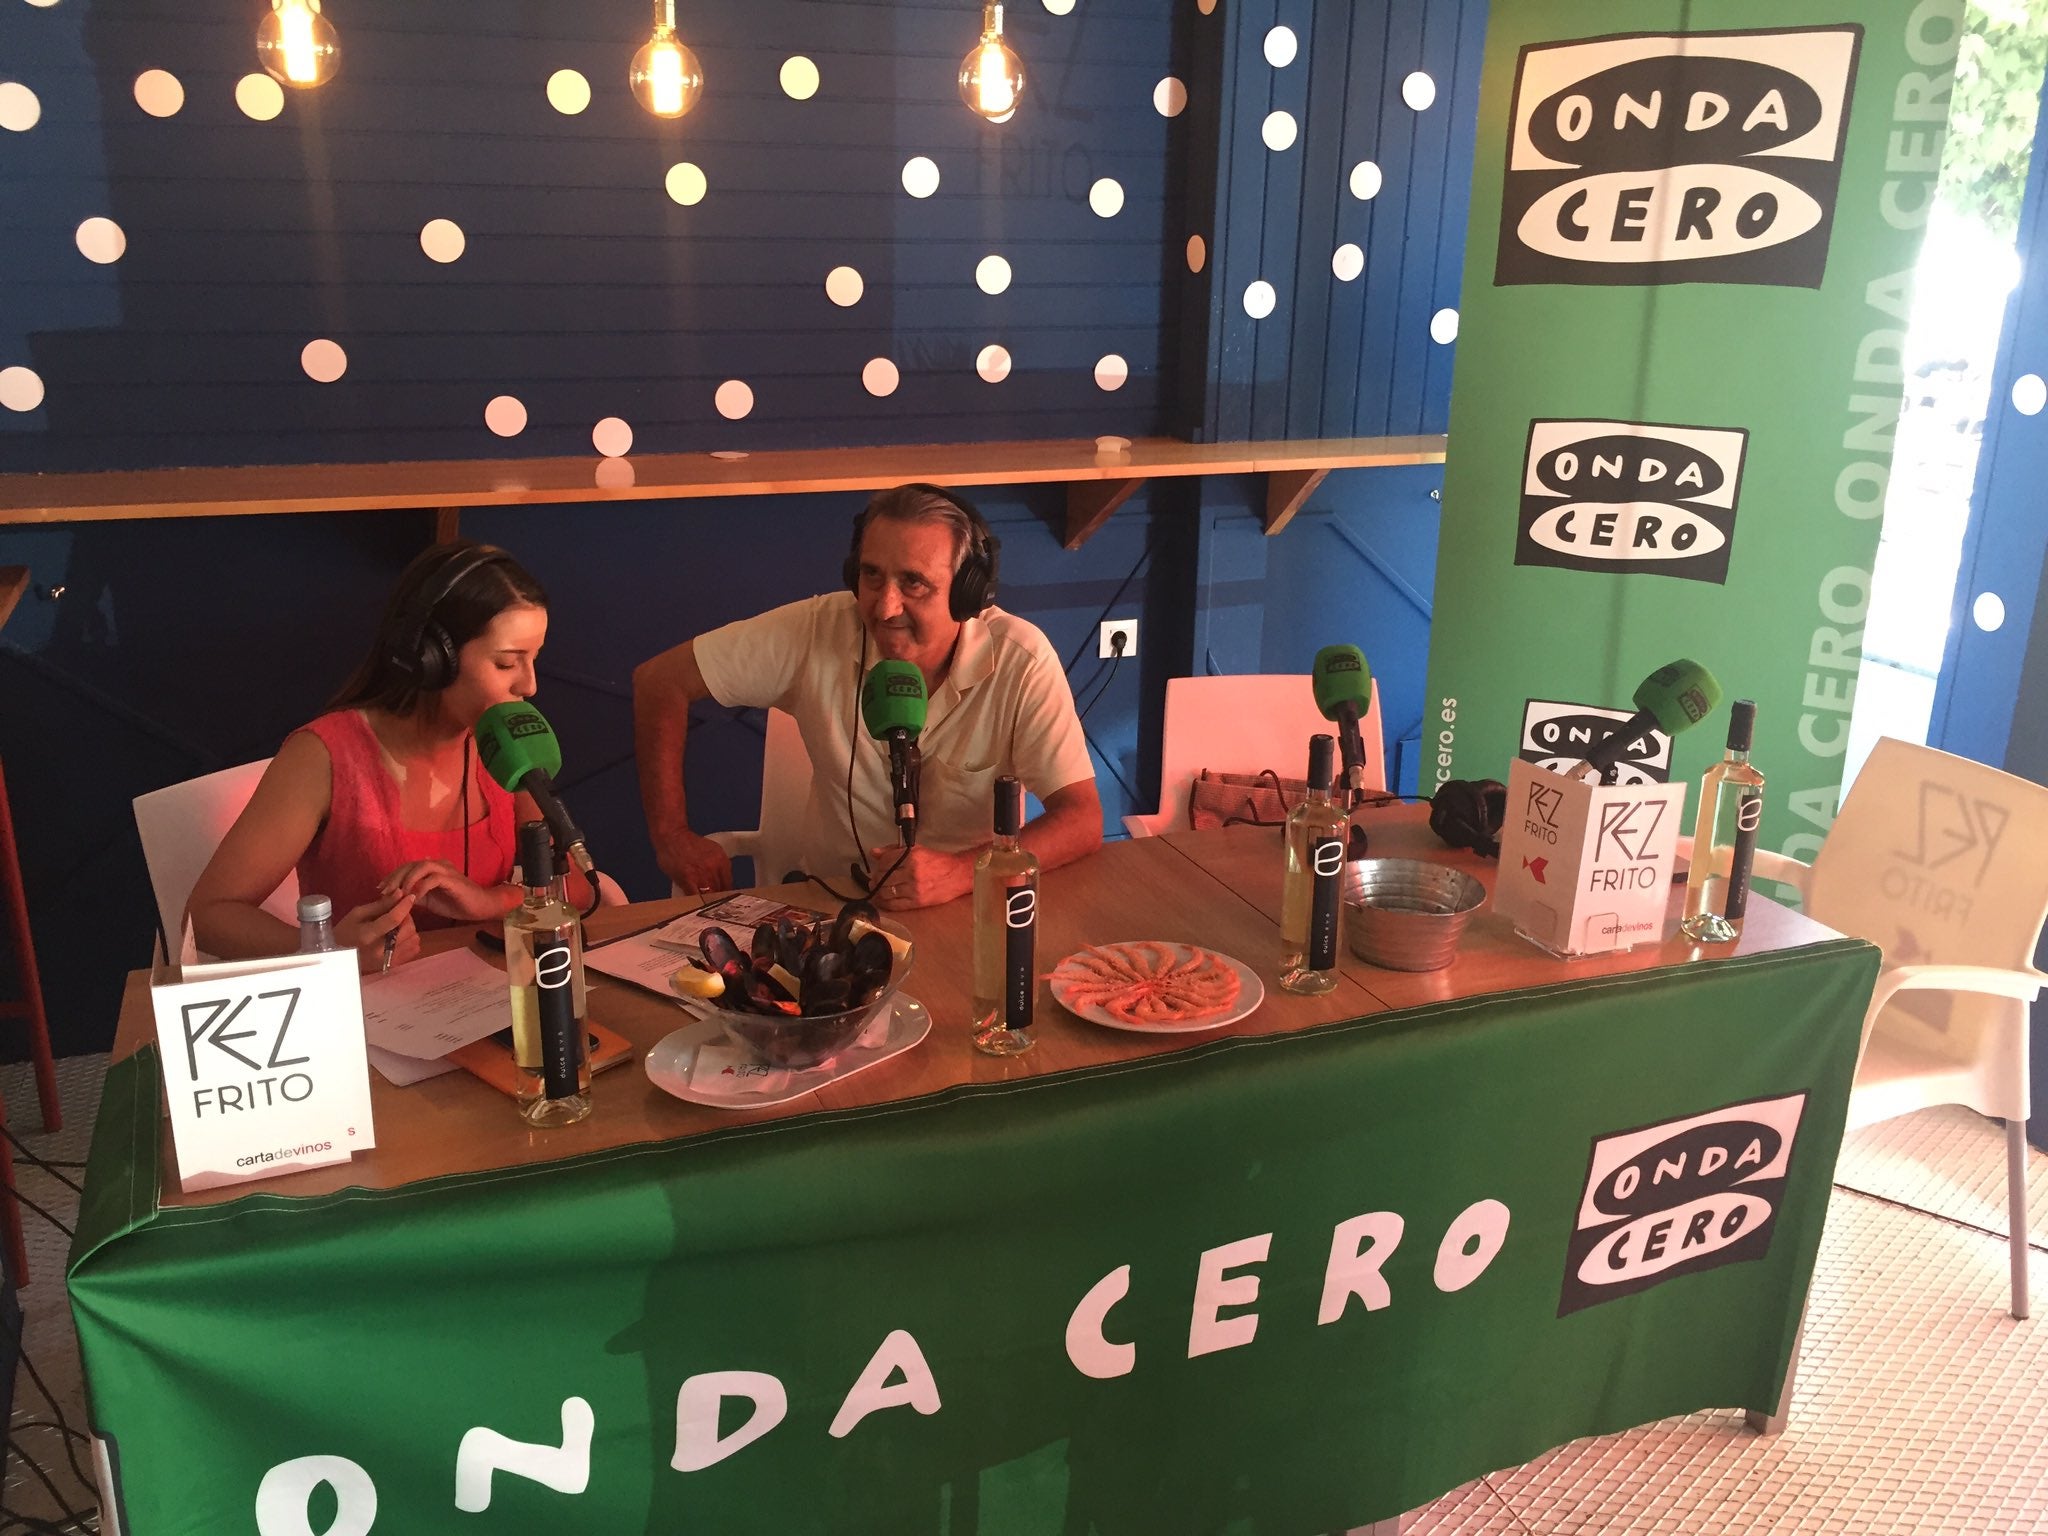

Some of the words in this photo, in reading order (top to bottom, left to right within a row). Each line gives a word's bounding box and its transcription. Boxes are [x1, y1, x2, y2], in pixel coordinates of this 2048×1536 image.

[1555, 89, 1790, 142] ONDA
[1879, 0, 1965, 231] CERO
[1555, 186, 1779, 242] CERO
[1834, 263, 1912, 521] ONDA
[1554, 451, 1705, 489] ONDA
[1555, 510, 1698, 551] CERO
[1797, 565, 1872, 758] CERO
[1435, 698, 1457, 793] cero.es
[1543, 722, 1648, 755] ONA
[1524, 820, 1558, 845] FRITO
[1526, 781, 1564, 829] PEZ
[1594, 800, 1668, 863] PEZ
[1590, 866, 1656, 892] FRITO
[180, 987, 310, 1081] PEZ
[193, 1072, 314, 1119] FRITO
[236, 1141, 332, 1167] cartadevinos
[1613, 1138, 1761, 1200] ONDA
[1607, 1204, 1748, 1270] CERO
[255, 1329, 942, 1536] ONDA
[1065, 1199, 1511, 1378] CERO
